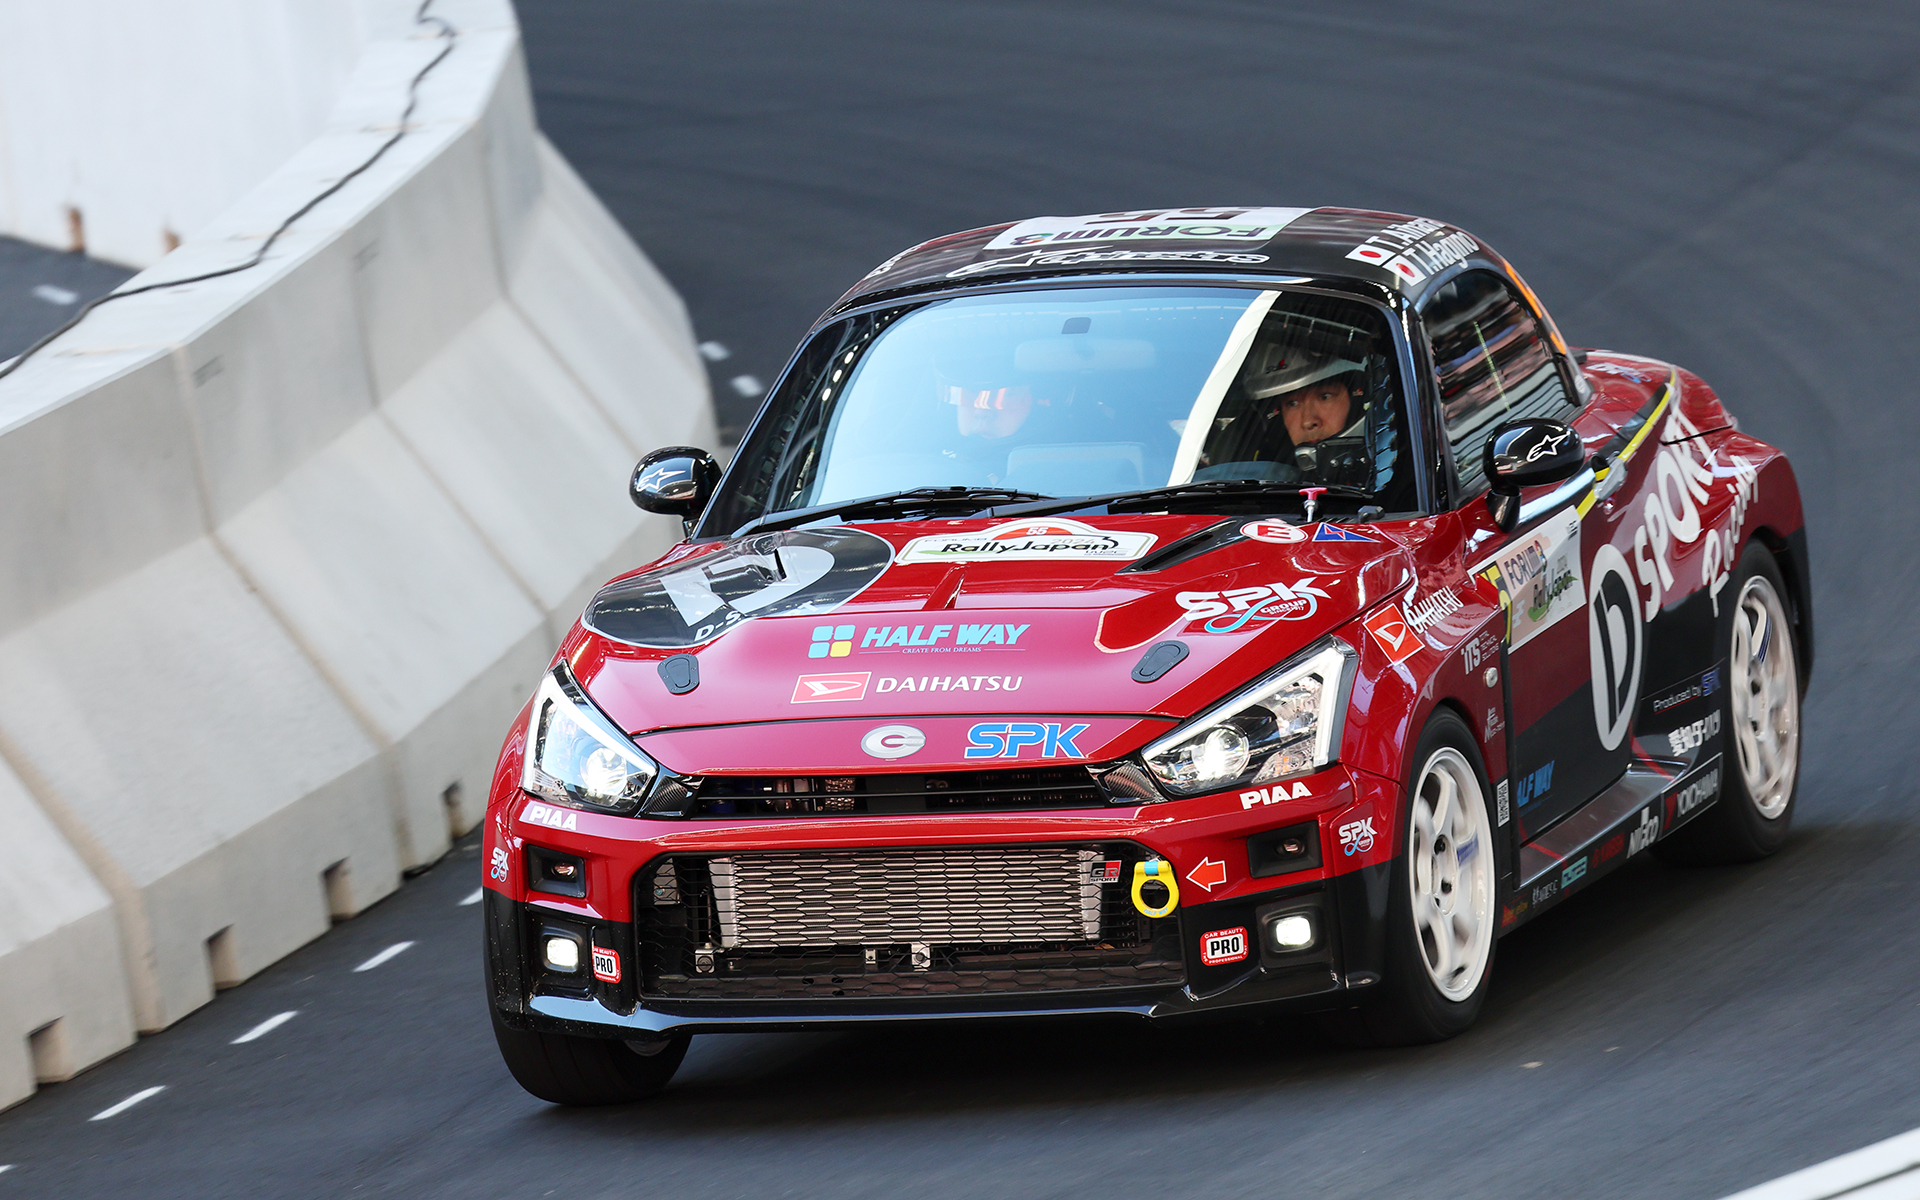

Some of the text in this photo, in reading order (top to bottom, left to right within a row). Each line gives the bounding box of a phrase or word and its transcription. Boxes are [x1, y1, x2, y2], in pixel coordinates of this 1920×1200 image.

[1026, 526, 1049, 536] 55
[1257, 524, 1291, 540] E
[1175, 577, 1331, 621] SPK
[1260, 600, 1307, 613] GROUP
[1408, 586, 1464, 634] DAIHATSU
[860, 624, 1031, 648] HALF WAY
[875, 675, 1023, 693] DAIHATSU
[964, 722, 1092, 759] SPK
[1239, 781, 1313, 810] PIAA
[529, 805, 577, 831] PIAA
[1338, 816, 1378, 845] SPK
[1091, 867, 1118, 877] GR
[1204, 928, 1244, 940] CAR BEAUTY
[1210, 937, 1240, 956] PRO
[595, 956, 614, 974] PRO
